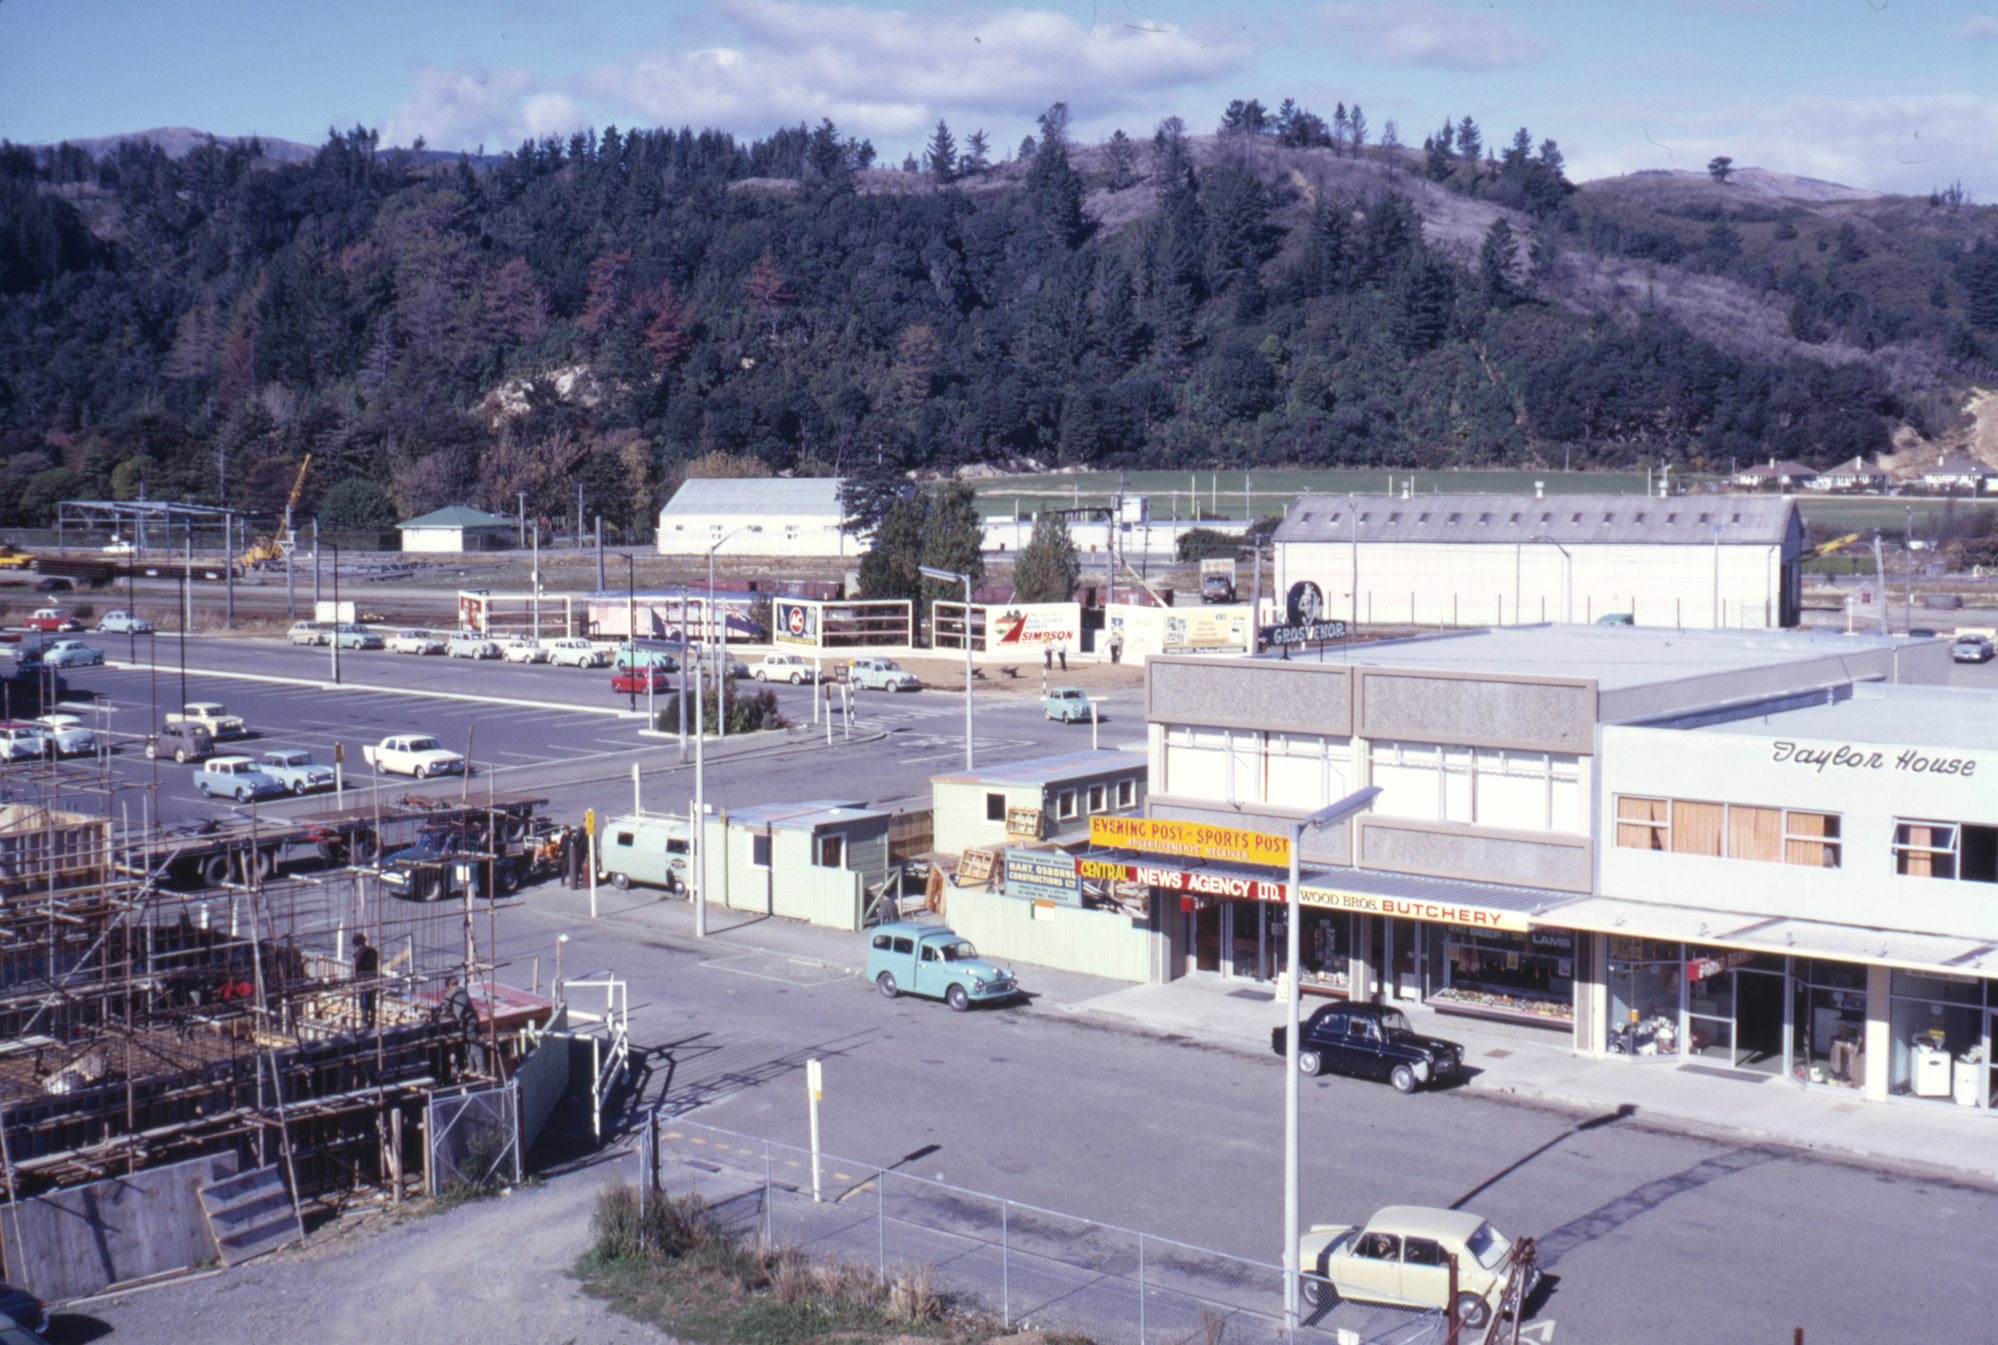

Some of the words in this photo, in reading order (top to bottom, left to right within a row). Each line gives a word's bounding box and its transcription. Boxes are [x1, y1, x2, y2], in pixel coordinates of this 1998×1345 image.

[790, 612, 803, 627] AC
[1021, 630, 1074, 642] SIMPSON
[1273, 622, 1346, 644] GROSVENOR
[1773, 741, 1883, 774] Taylor
[1895, 749, 1976, 777] House
[1093, 817, 1146, 838] EVENING
[1151, 823, 1184, 841] POST
[1196, 828, 1249, 849] SPORTS
[1255, 834, 1289, 853] POST
[1127, 838, 1200, 855] ADVERTISEMENTS
[1206, 846, 1249, 860] RECEIVED
[1008, 871, 1064, 887] CONSTRUCTIONS
[1080, 860, 1130, 881] CENTRAL
[1137, 867, 1183, 889] NEWS
[1187, 874, 1251, 898] AGENCY
[1258, 882, 1281, 901] LTD.
[1300, 890, 1340, 906] WOOD
[1382, 899, 1502, 926] BUTCHERY
[1532, 933, 1571, 948] LAMB
